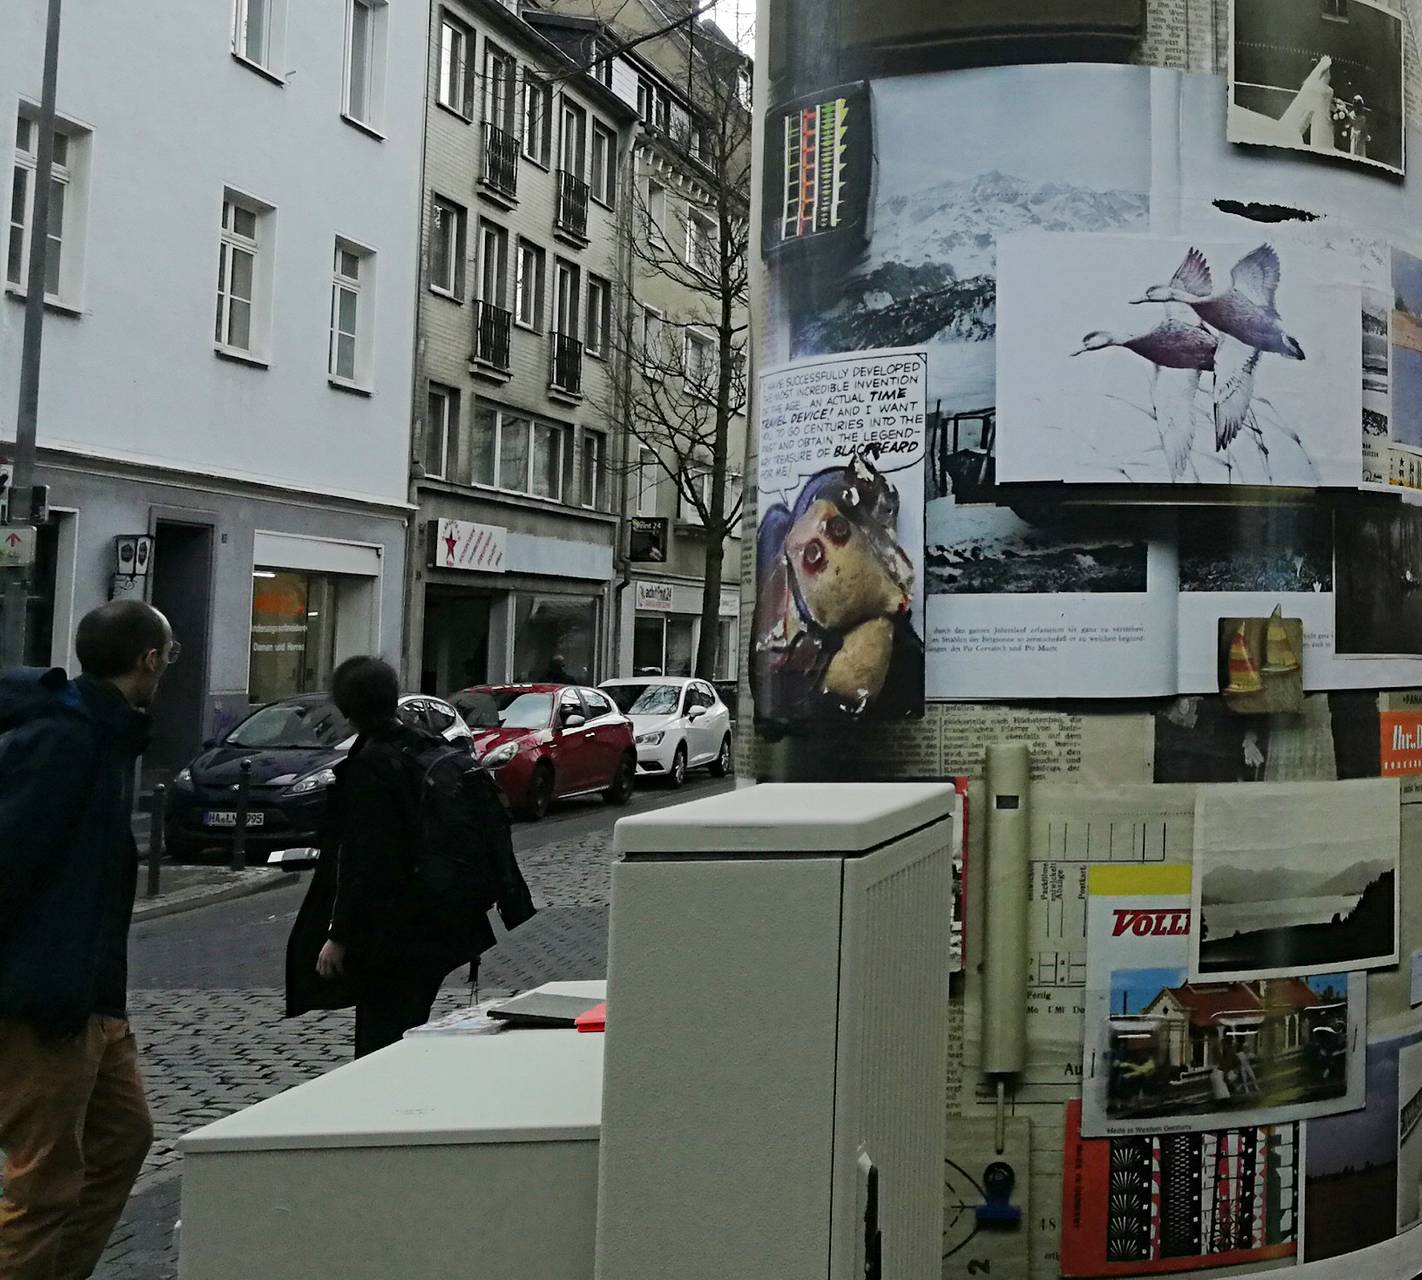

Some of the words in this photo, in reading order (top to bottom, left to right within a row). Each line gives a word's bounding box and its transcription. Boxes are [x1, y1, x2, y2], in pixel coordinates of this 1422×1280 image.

[786, 368, 849, 387] SUCCESSFULLY
[853, 362, 921, 377] DEVELOPED
[798, 382, 849, 397] INCREDIBLE
[854, 375, 918, 389] INVENTION
[810, 399, 822, 408] AN
[827, 393, 865, 405] ACTUAL
[870, 387, 907, 402] TIME
[790, 407, 834, 424] DEVICE!
[837, 406, 860, 417] AND
[866, 405, 872, 415] I
[880, 401, 918, 413] WANT
[788, 426, 801, 437] GO
[803, 418, 864, 435] CENTURIES
[871, 416, 896, 427] INTO
[900, 414, 924, 425] THE
[797, 436, 834, 448] OBTAIN
[839, 432, 858, 443] THE
[864, 427, 921, 442] LEGEND-
[773, 450, 813, 464] TREASURE
[816, 448, 831, 458] OF
[1392, 724, 1412, 751] Ihr
[1026, 991, 1051, 1001] Fertig
[1026, 1006, 1039, 1014] Mo
